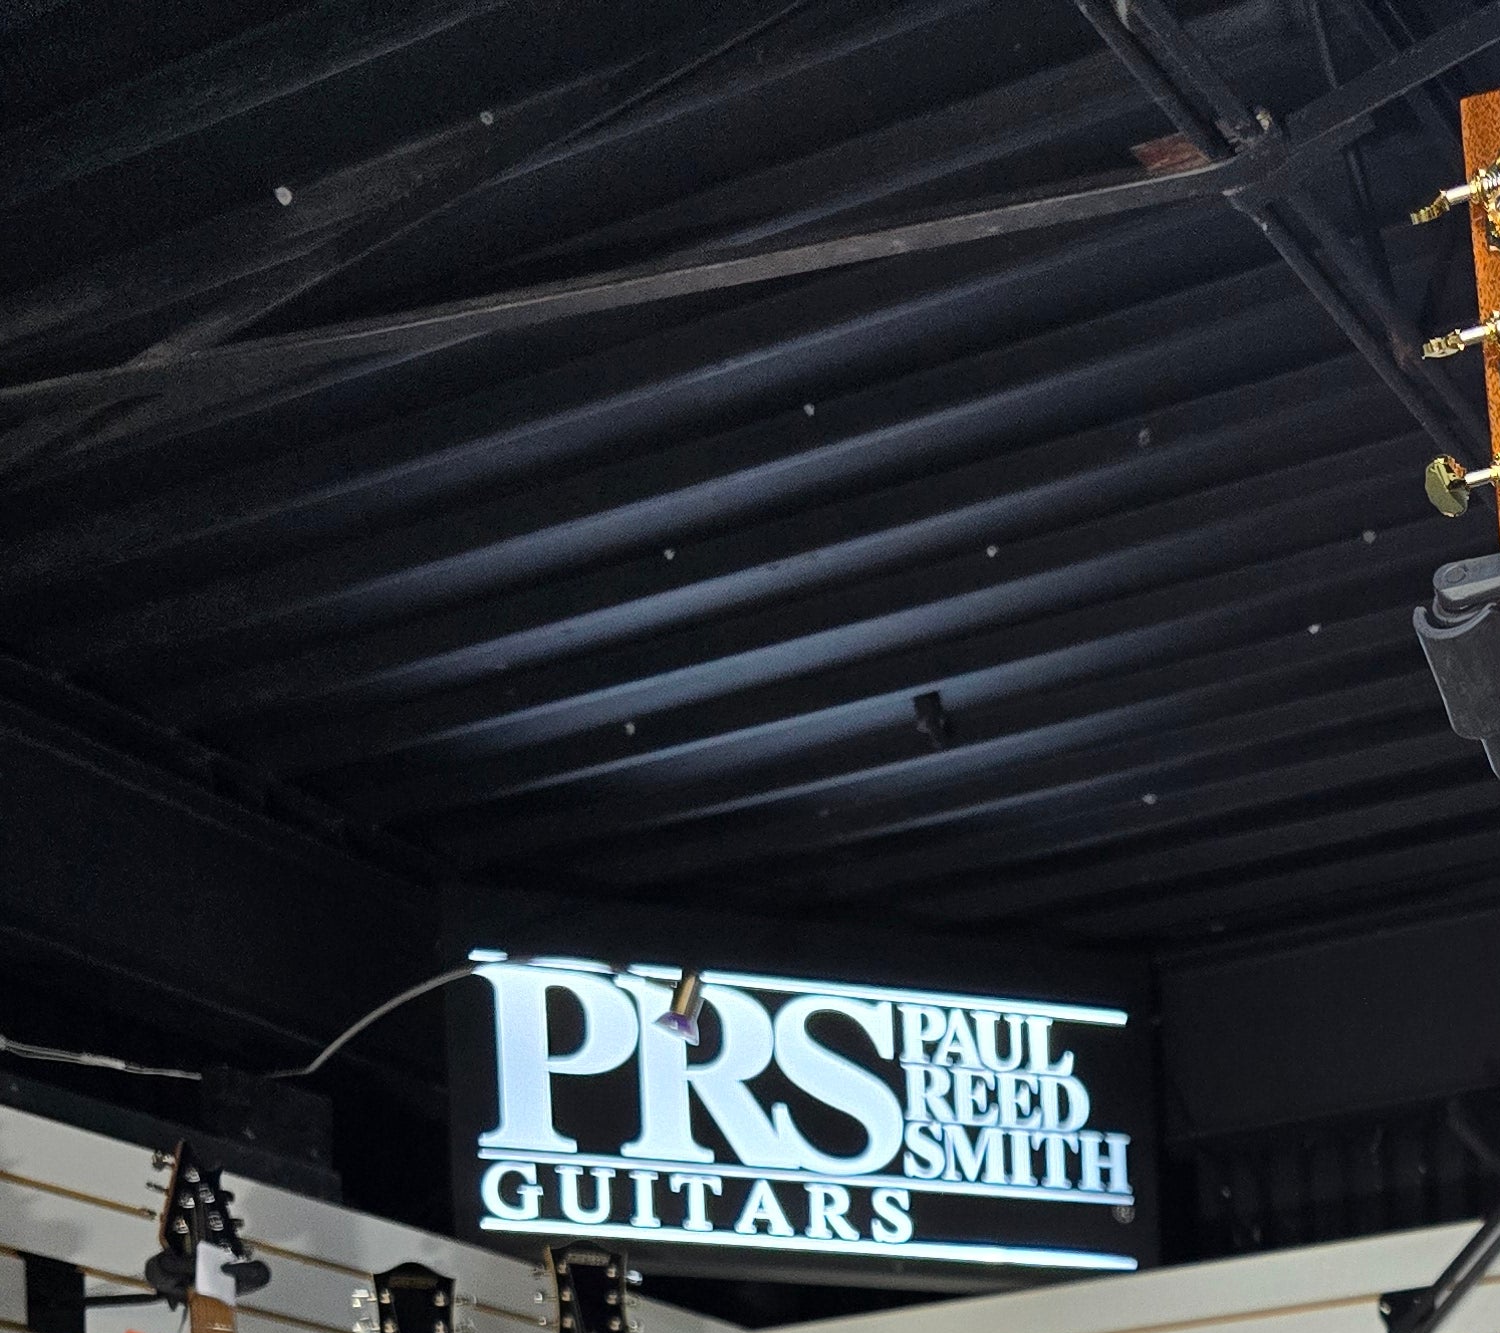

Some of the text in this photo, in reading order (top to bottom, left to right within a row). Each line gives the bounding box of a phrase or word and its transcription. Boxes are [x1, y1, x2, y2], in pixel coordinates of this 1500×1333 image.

[471, 962, 905, 1177] PRS
[898, 1002, 1075, 1077] PAUL
[901, 1061, 1092, 1134] REED
[903, 1122, 1132, 1195] SMITH
[480, 1161, 916, 1244] GUITARS
